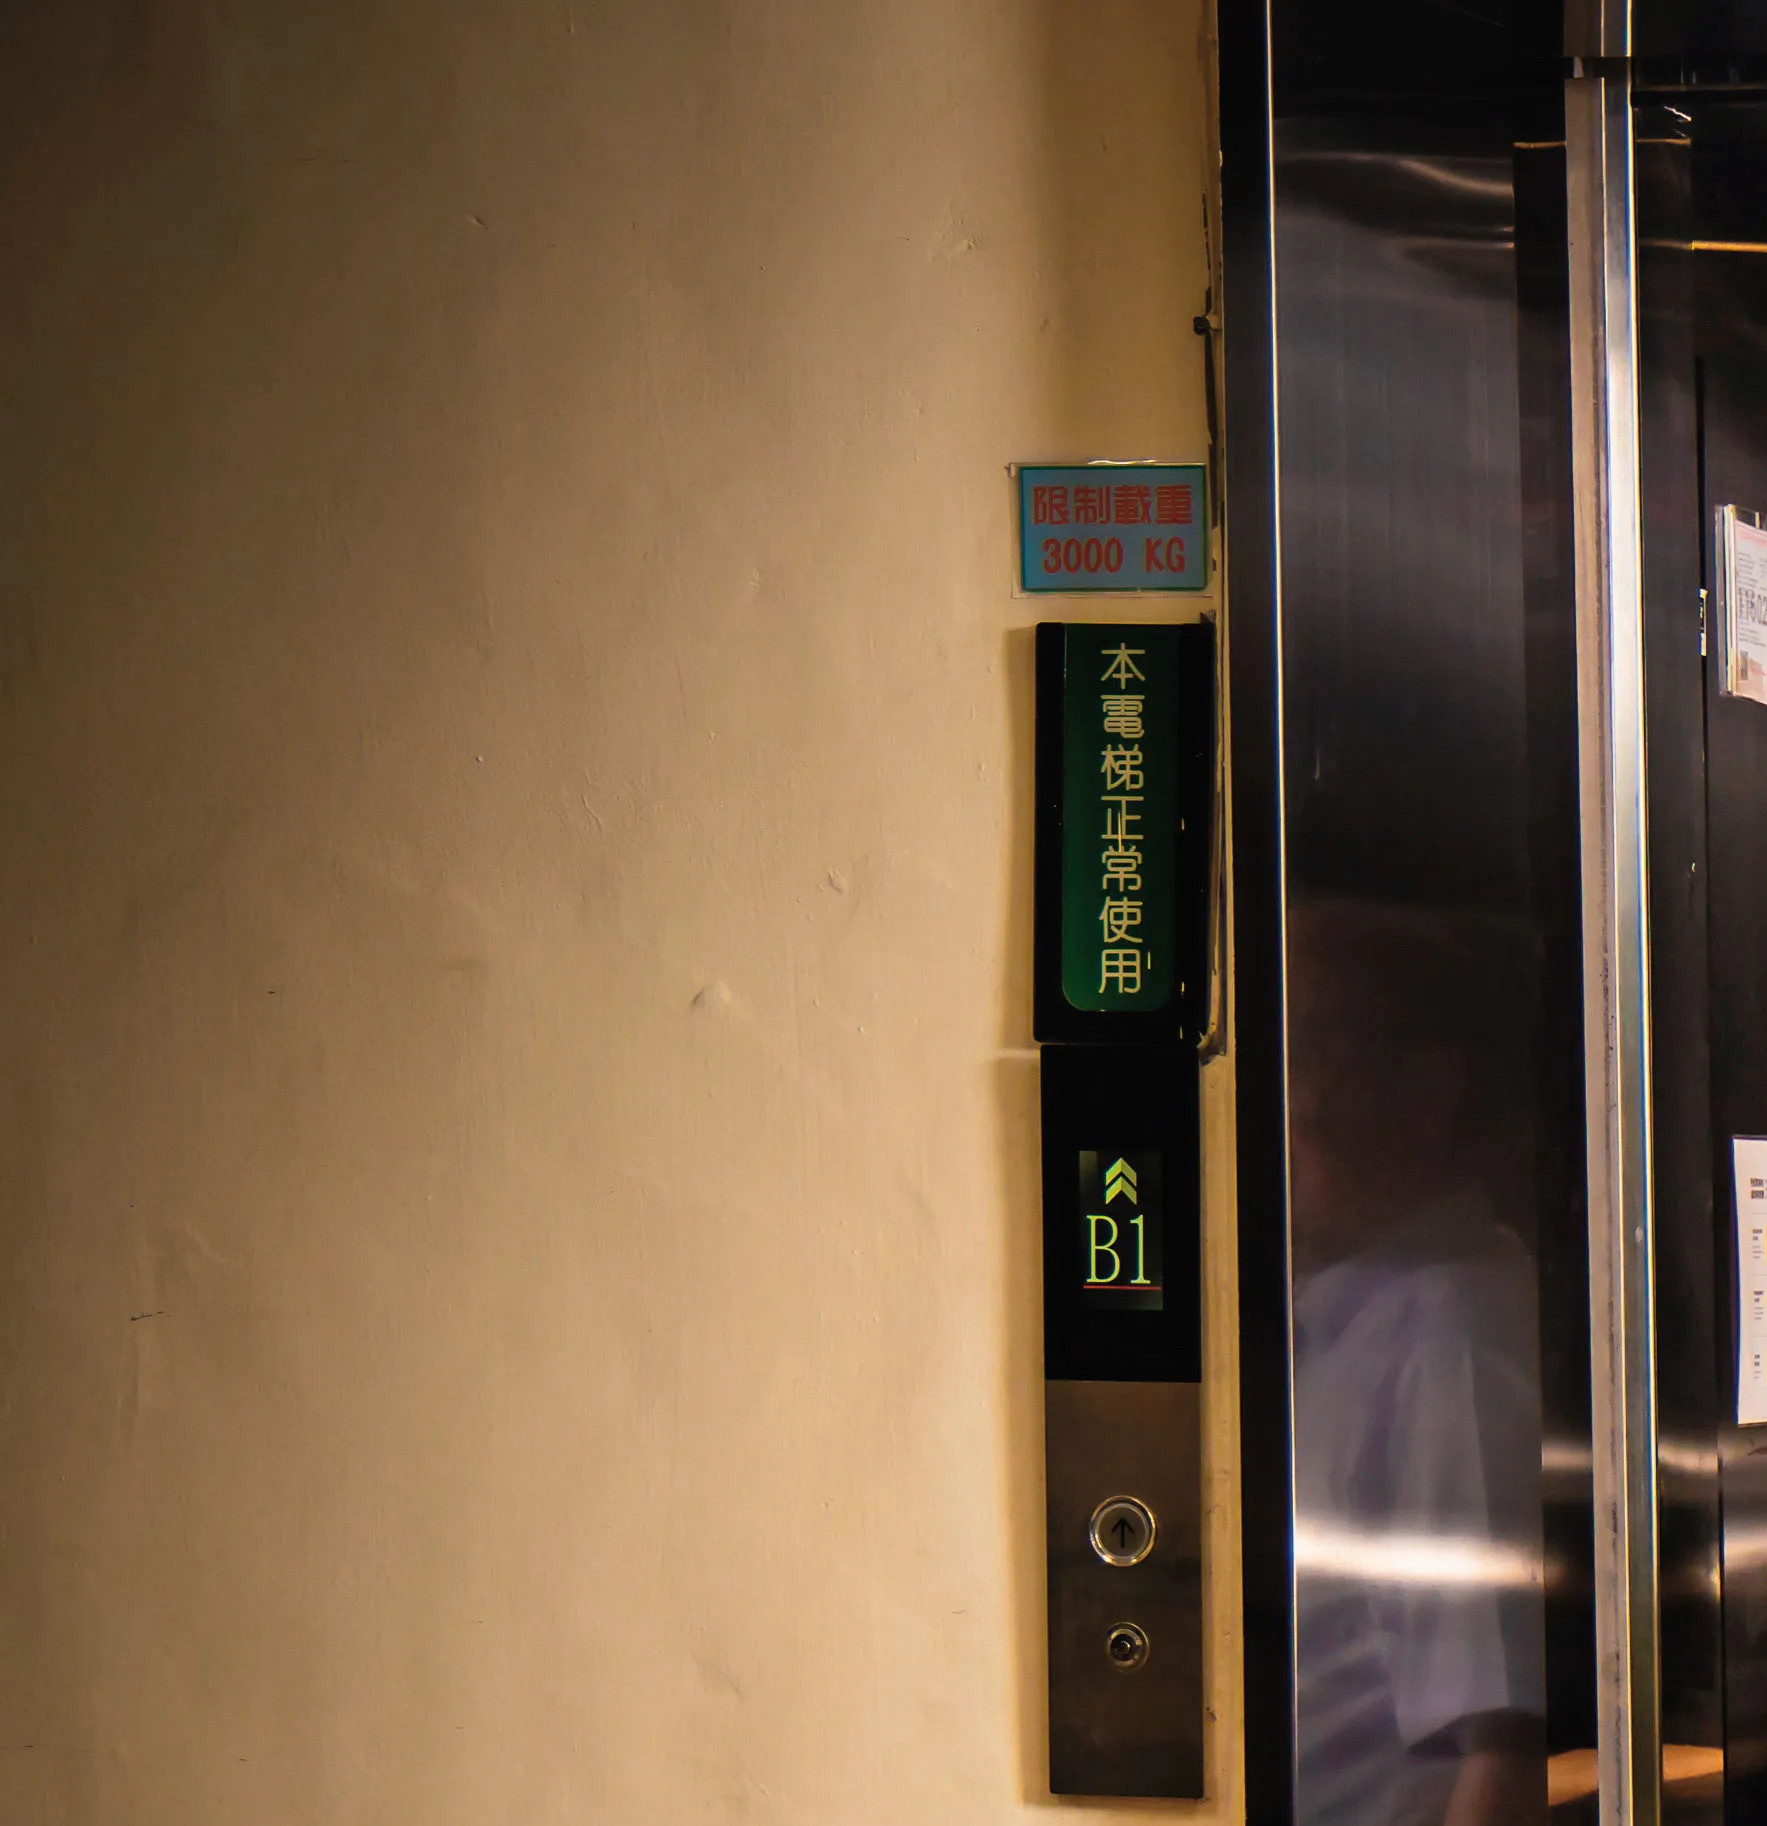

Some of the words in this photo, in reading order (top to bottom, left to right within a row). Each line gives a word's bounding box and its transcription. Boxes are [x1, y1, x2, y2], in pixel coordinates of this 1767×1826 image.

[1032, 485, 1193, 525] 限制載重
[1043, 537, 1124, 574] 3000
[1145, 537, 1186, 573] KG
[1098, 642, 1147, 995] 本電梯正常使用
[1085, 1214, 1151, 1285] B1
